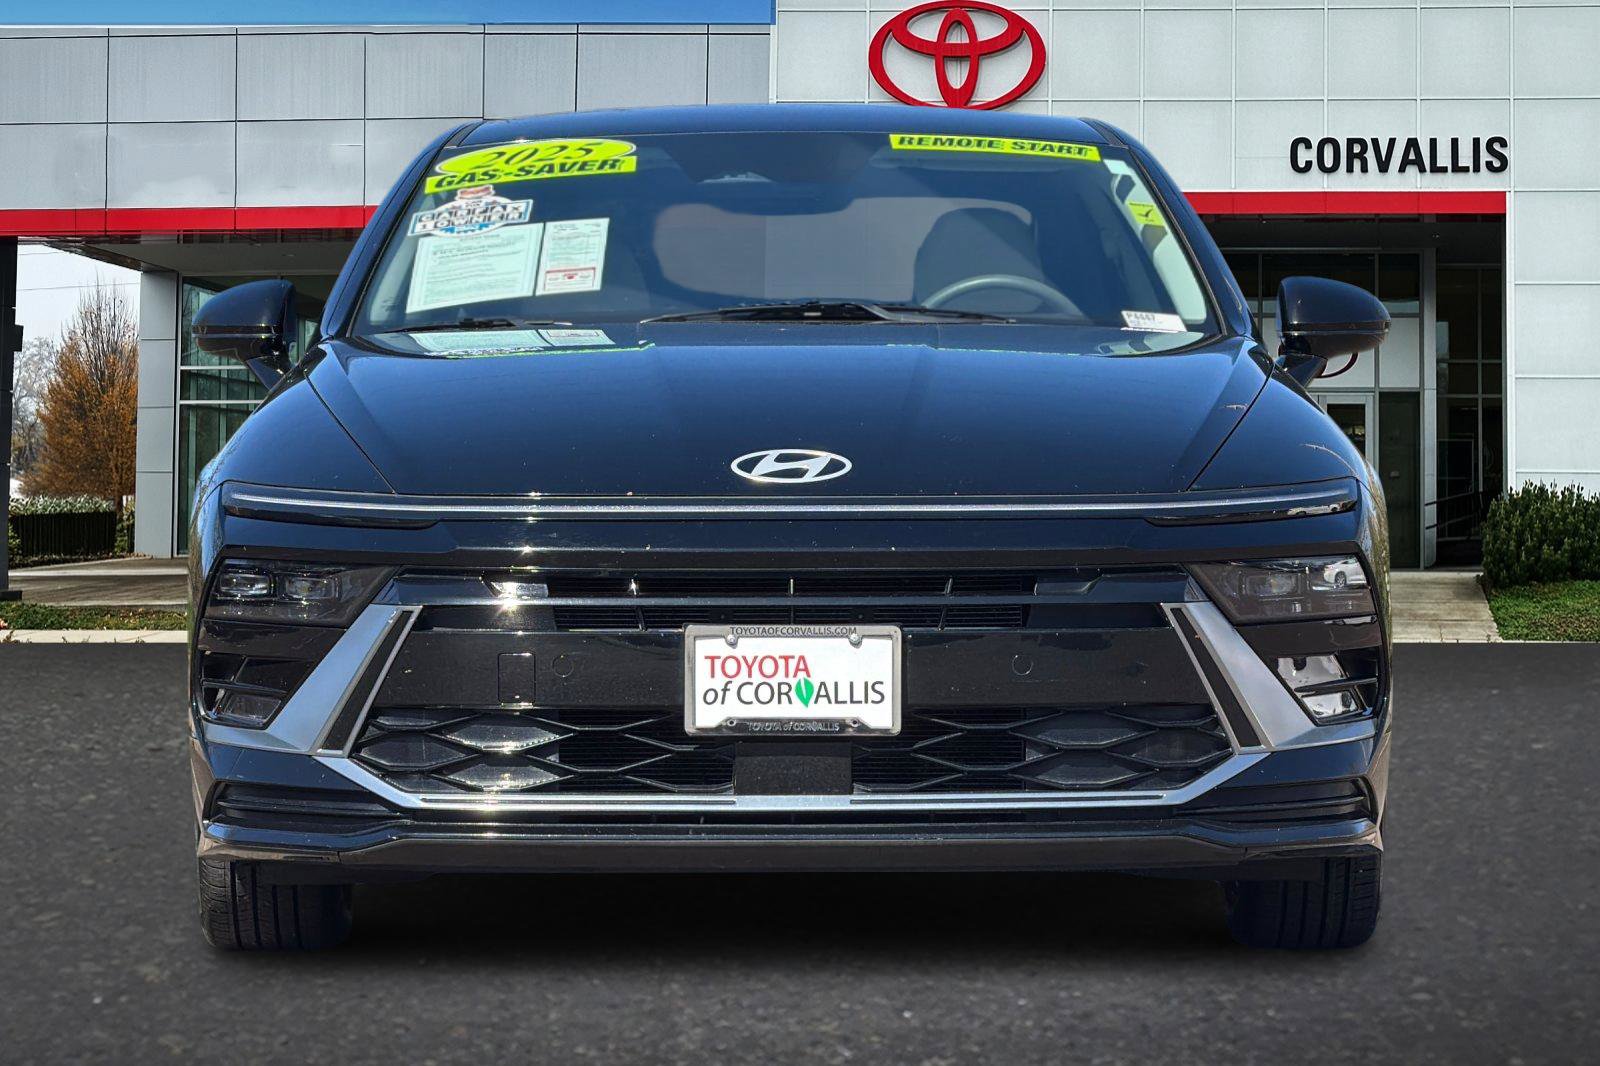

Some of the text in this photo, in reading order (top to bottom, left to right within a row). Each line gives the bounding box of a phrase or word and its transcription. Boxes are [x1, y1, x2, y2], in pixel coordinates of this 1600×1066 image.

[474, 143, 602, 169] 2025
[899, 136, 1090, 157] REMOTE START
[1290, 136, 1509, 173] CORVALLIS
[730, 626, 857, 636] TOYOTAOFCORVALLIS.COM
[704, 655, 811, 678] TOYOTA
[703, 680, 885, 707] of CORVALLIS
